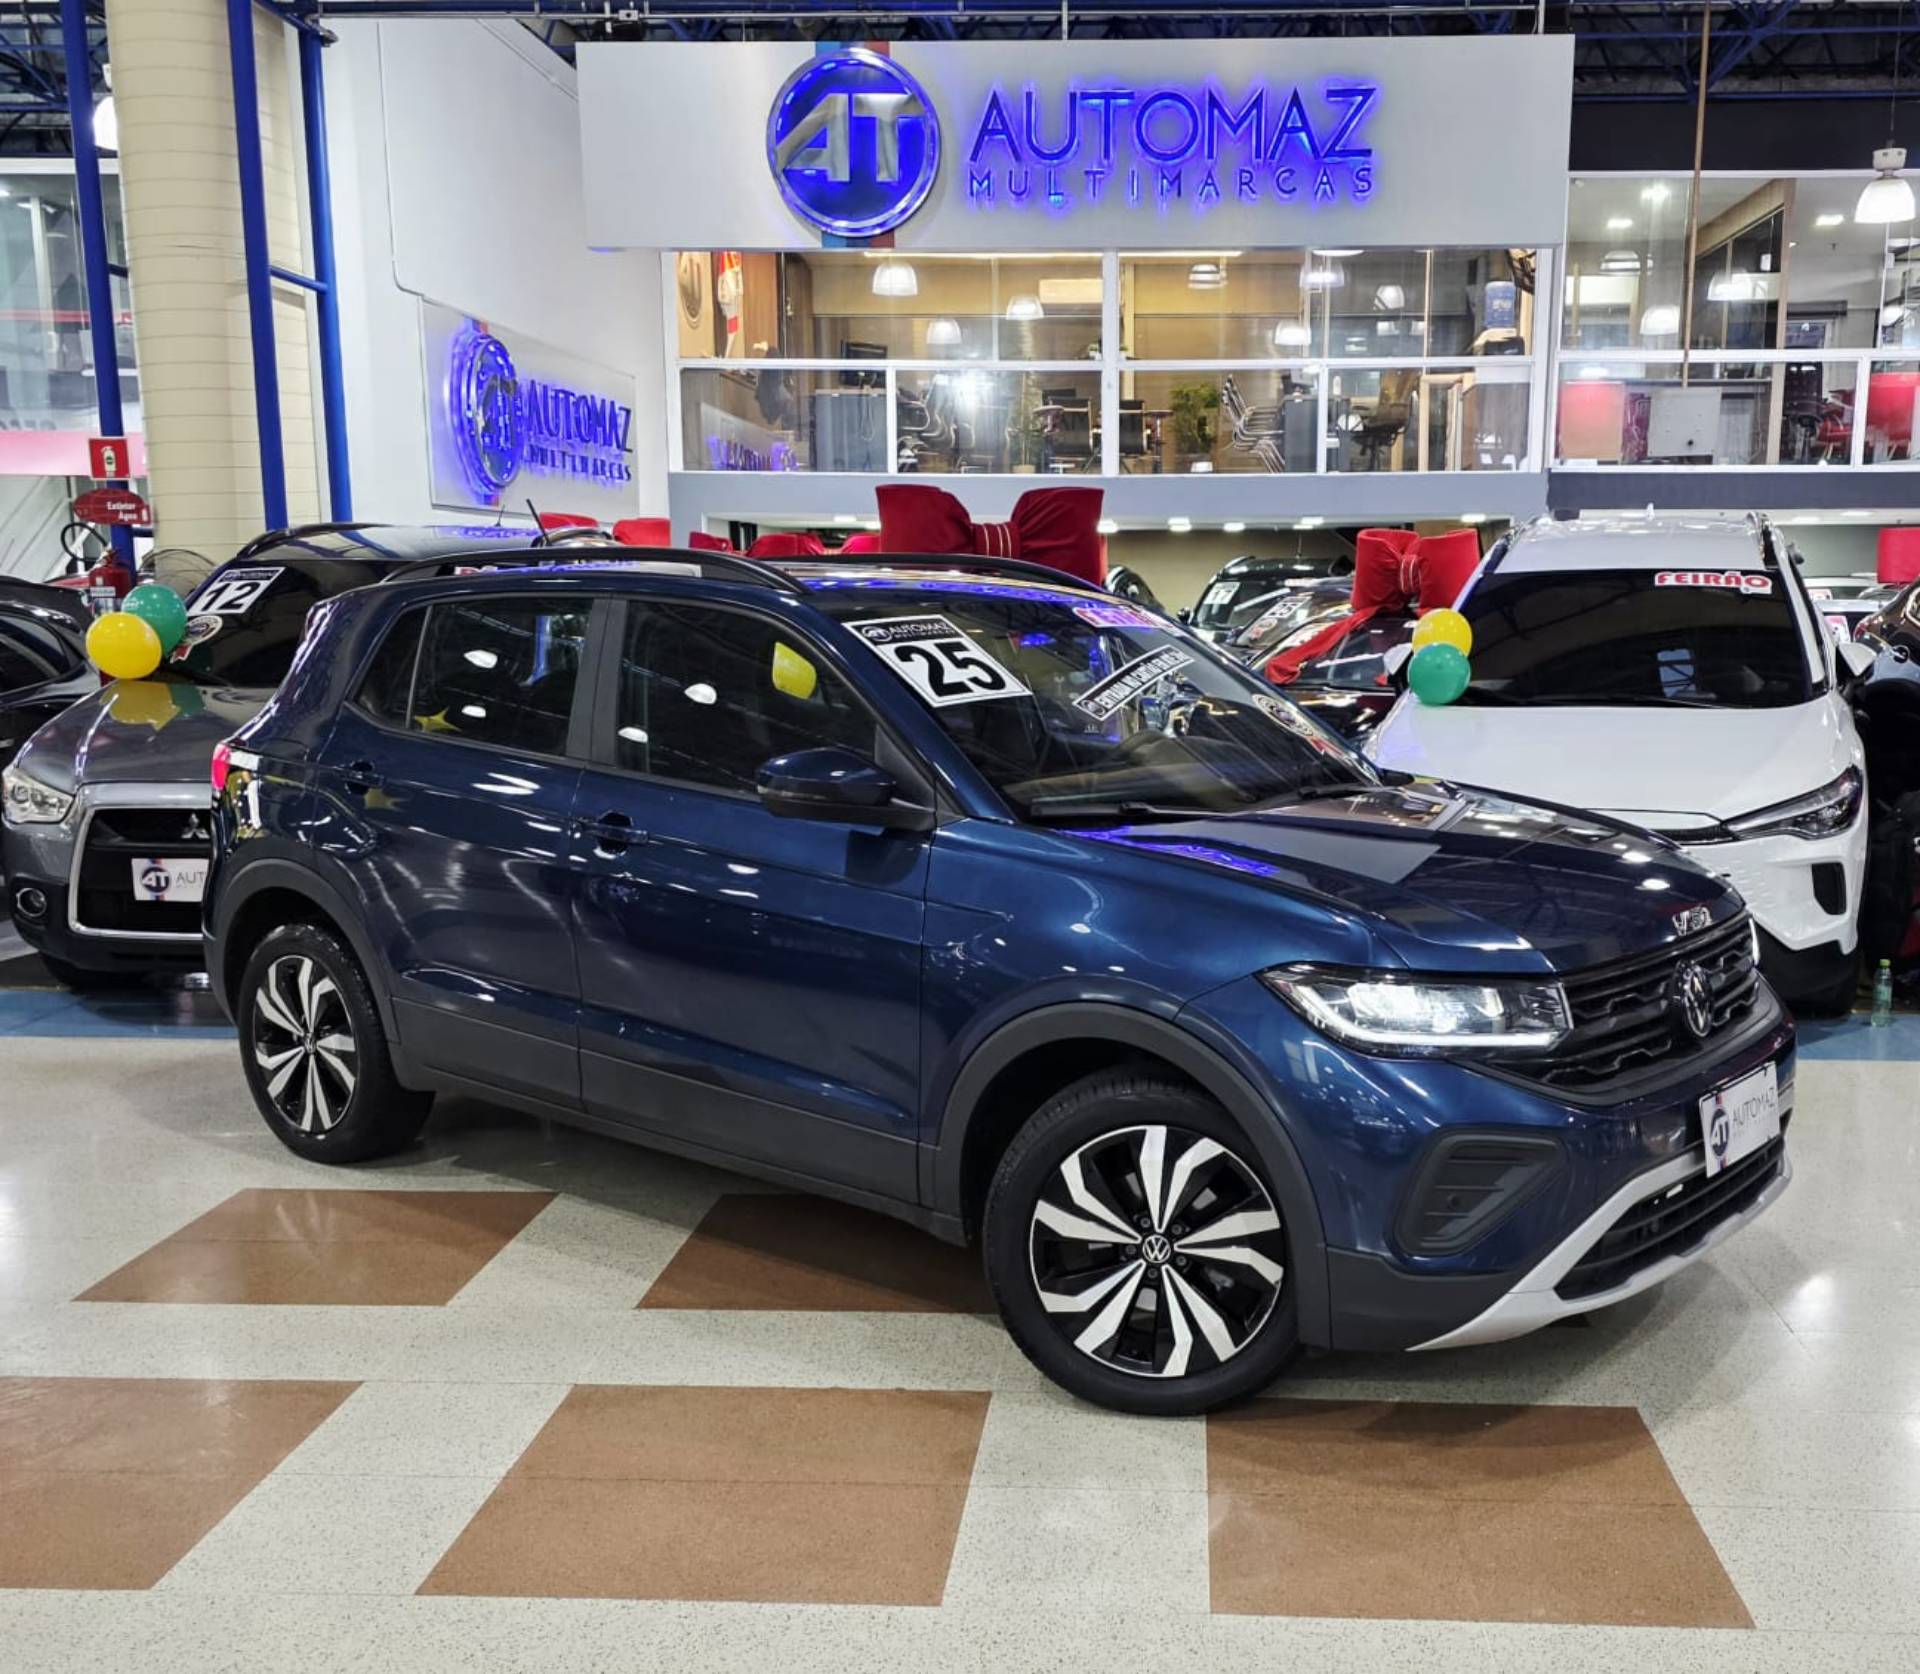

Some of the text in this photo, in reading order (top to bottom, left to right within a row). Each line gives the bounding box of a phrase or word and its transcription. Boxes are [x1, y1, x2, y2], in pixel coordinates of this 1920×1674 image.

[775, 92, 923, 182] AT
[969, 86, 1377, 161] AUTOMAZ
[969, 168, 1372, 197] MULTIMARCAS
[526, 379, 634, 452] AUTOMAZ
[528, 443, 633, 481] MULTIMARCAS
[201, 581, 261, 612] 12
[1656, 572, 1770, 589] FEIRÃO
[894, 641, 1006, 697] 25
